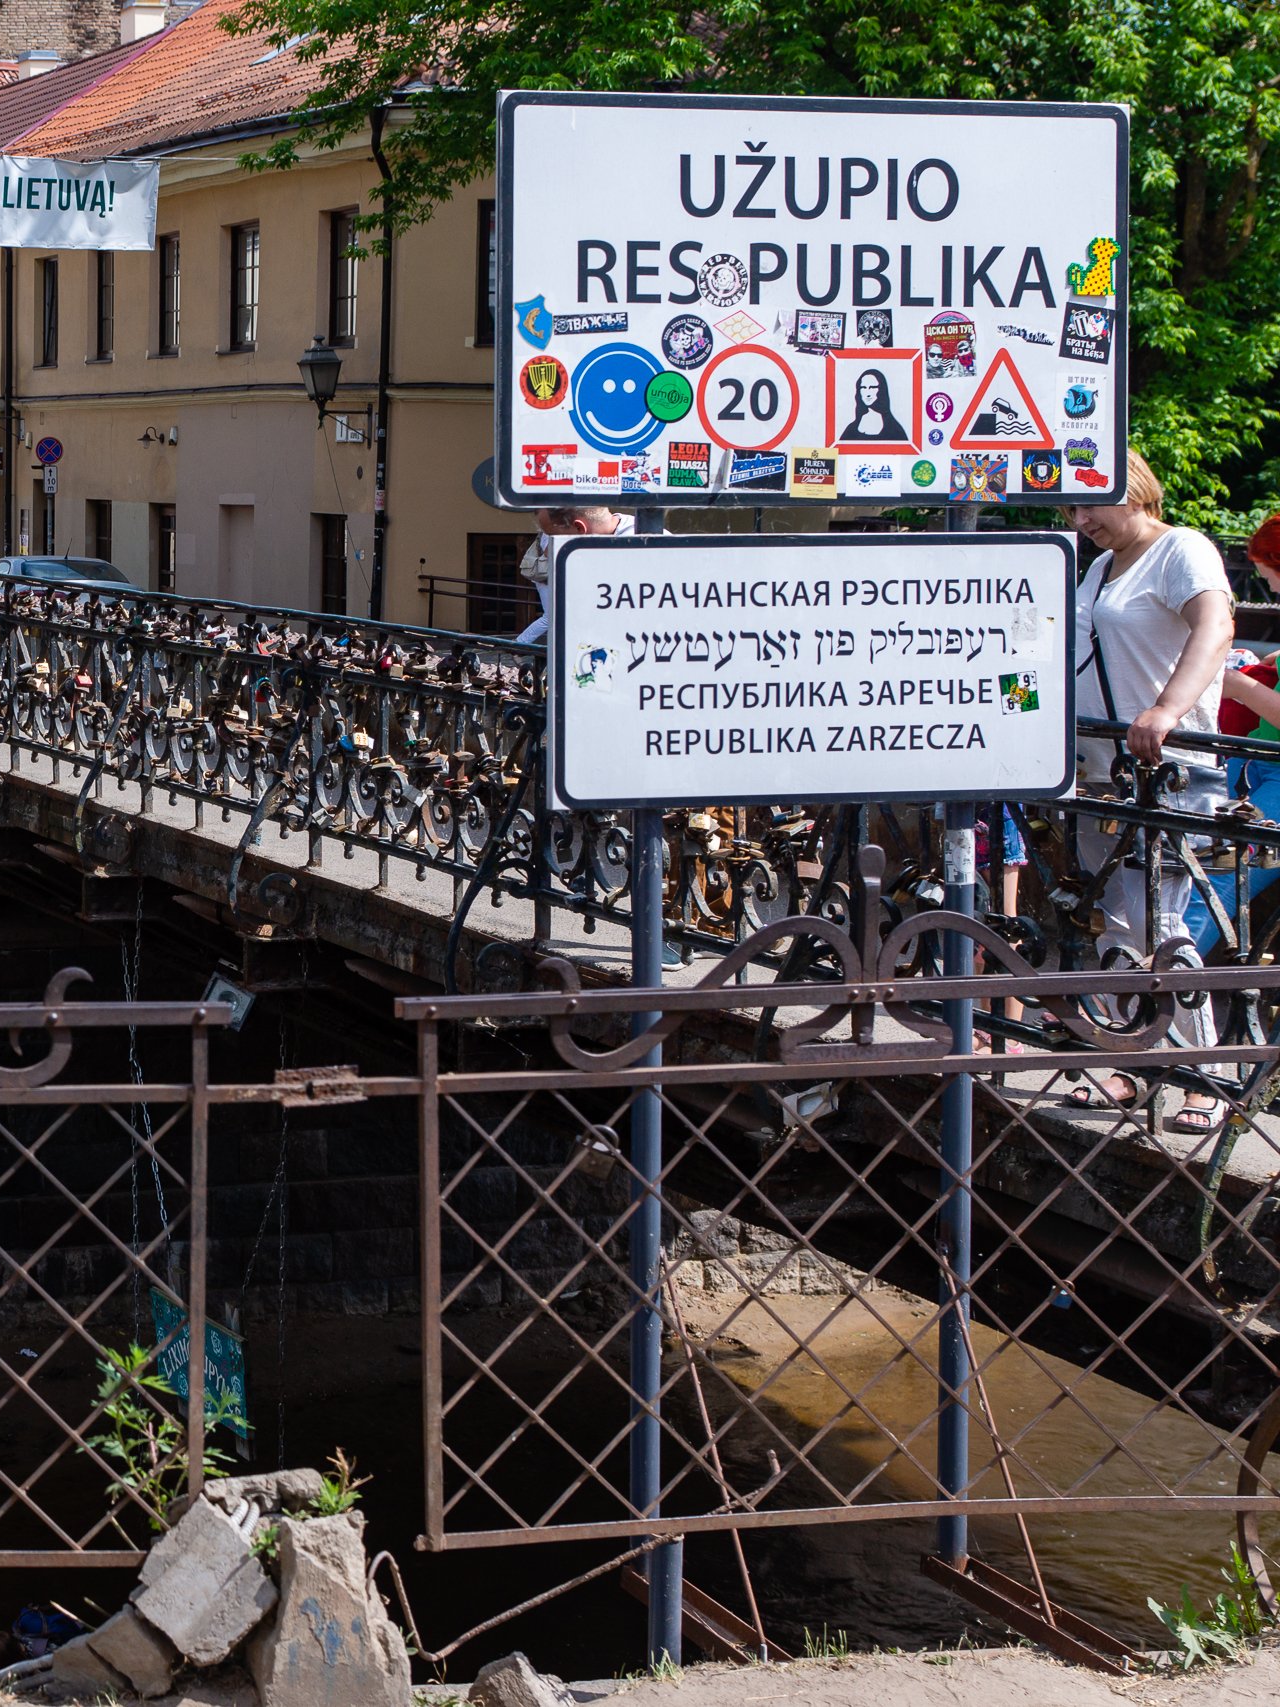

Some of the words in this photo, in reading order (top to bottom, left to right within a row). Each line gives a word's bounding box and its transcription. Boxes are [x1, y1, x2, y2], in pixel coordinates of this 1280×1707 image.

[2, 175, 115, 219] LIETUVĄ!
[679, 141, 960, 222] UŽUPIO
[577, 239, 703, 305] RES
[750, 243, 1057, 309] PUBLIKA
[718, 379, 778, 421] 20
[669, 460, 680, 469] TO
[680, 460, 708, 470] NASZA
[670, 443, 709, 455] LEGIA
[596, 581, 830, 610] ЗАРАЧАНСКАЯ
[842, 578, 1034, 606] РЭСПУБЛІКА
[815, 629, 855, 666] פון
[639, 681, 848, 711] РЕСПУБЛИКА
[859, 678, 993, 707] ЗАРЕЧЬЕ
[646, 726, 817, 756] REPUBLIKA
[826, 723, 986, 752] ZARZECZA
